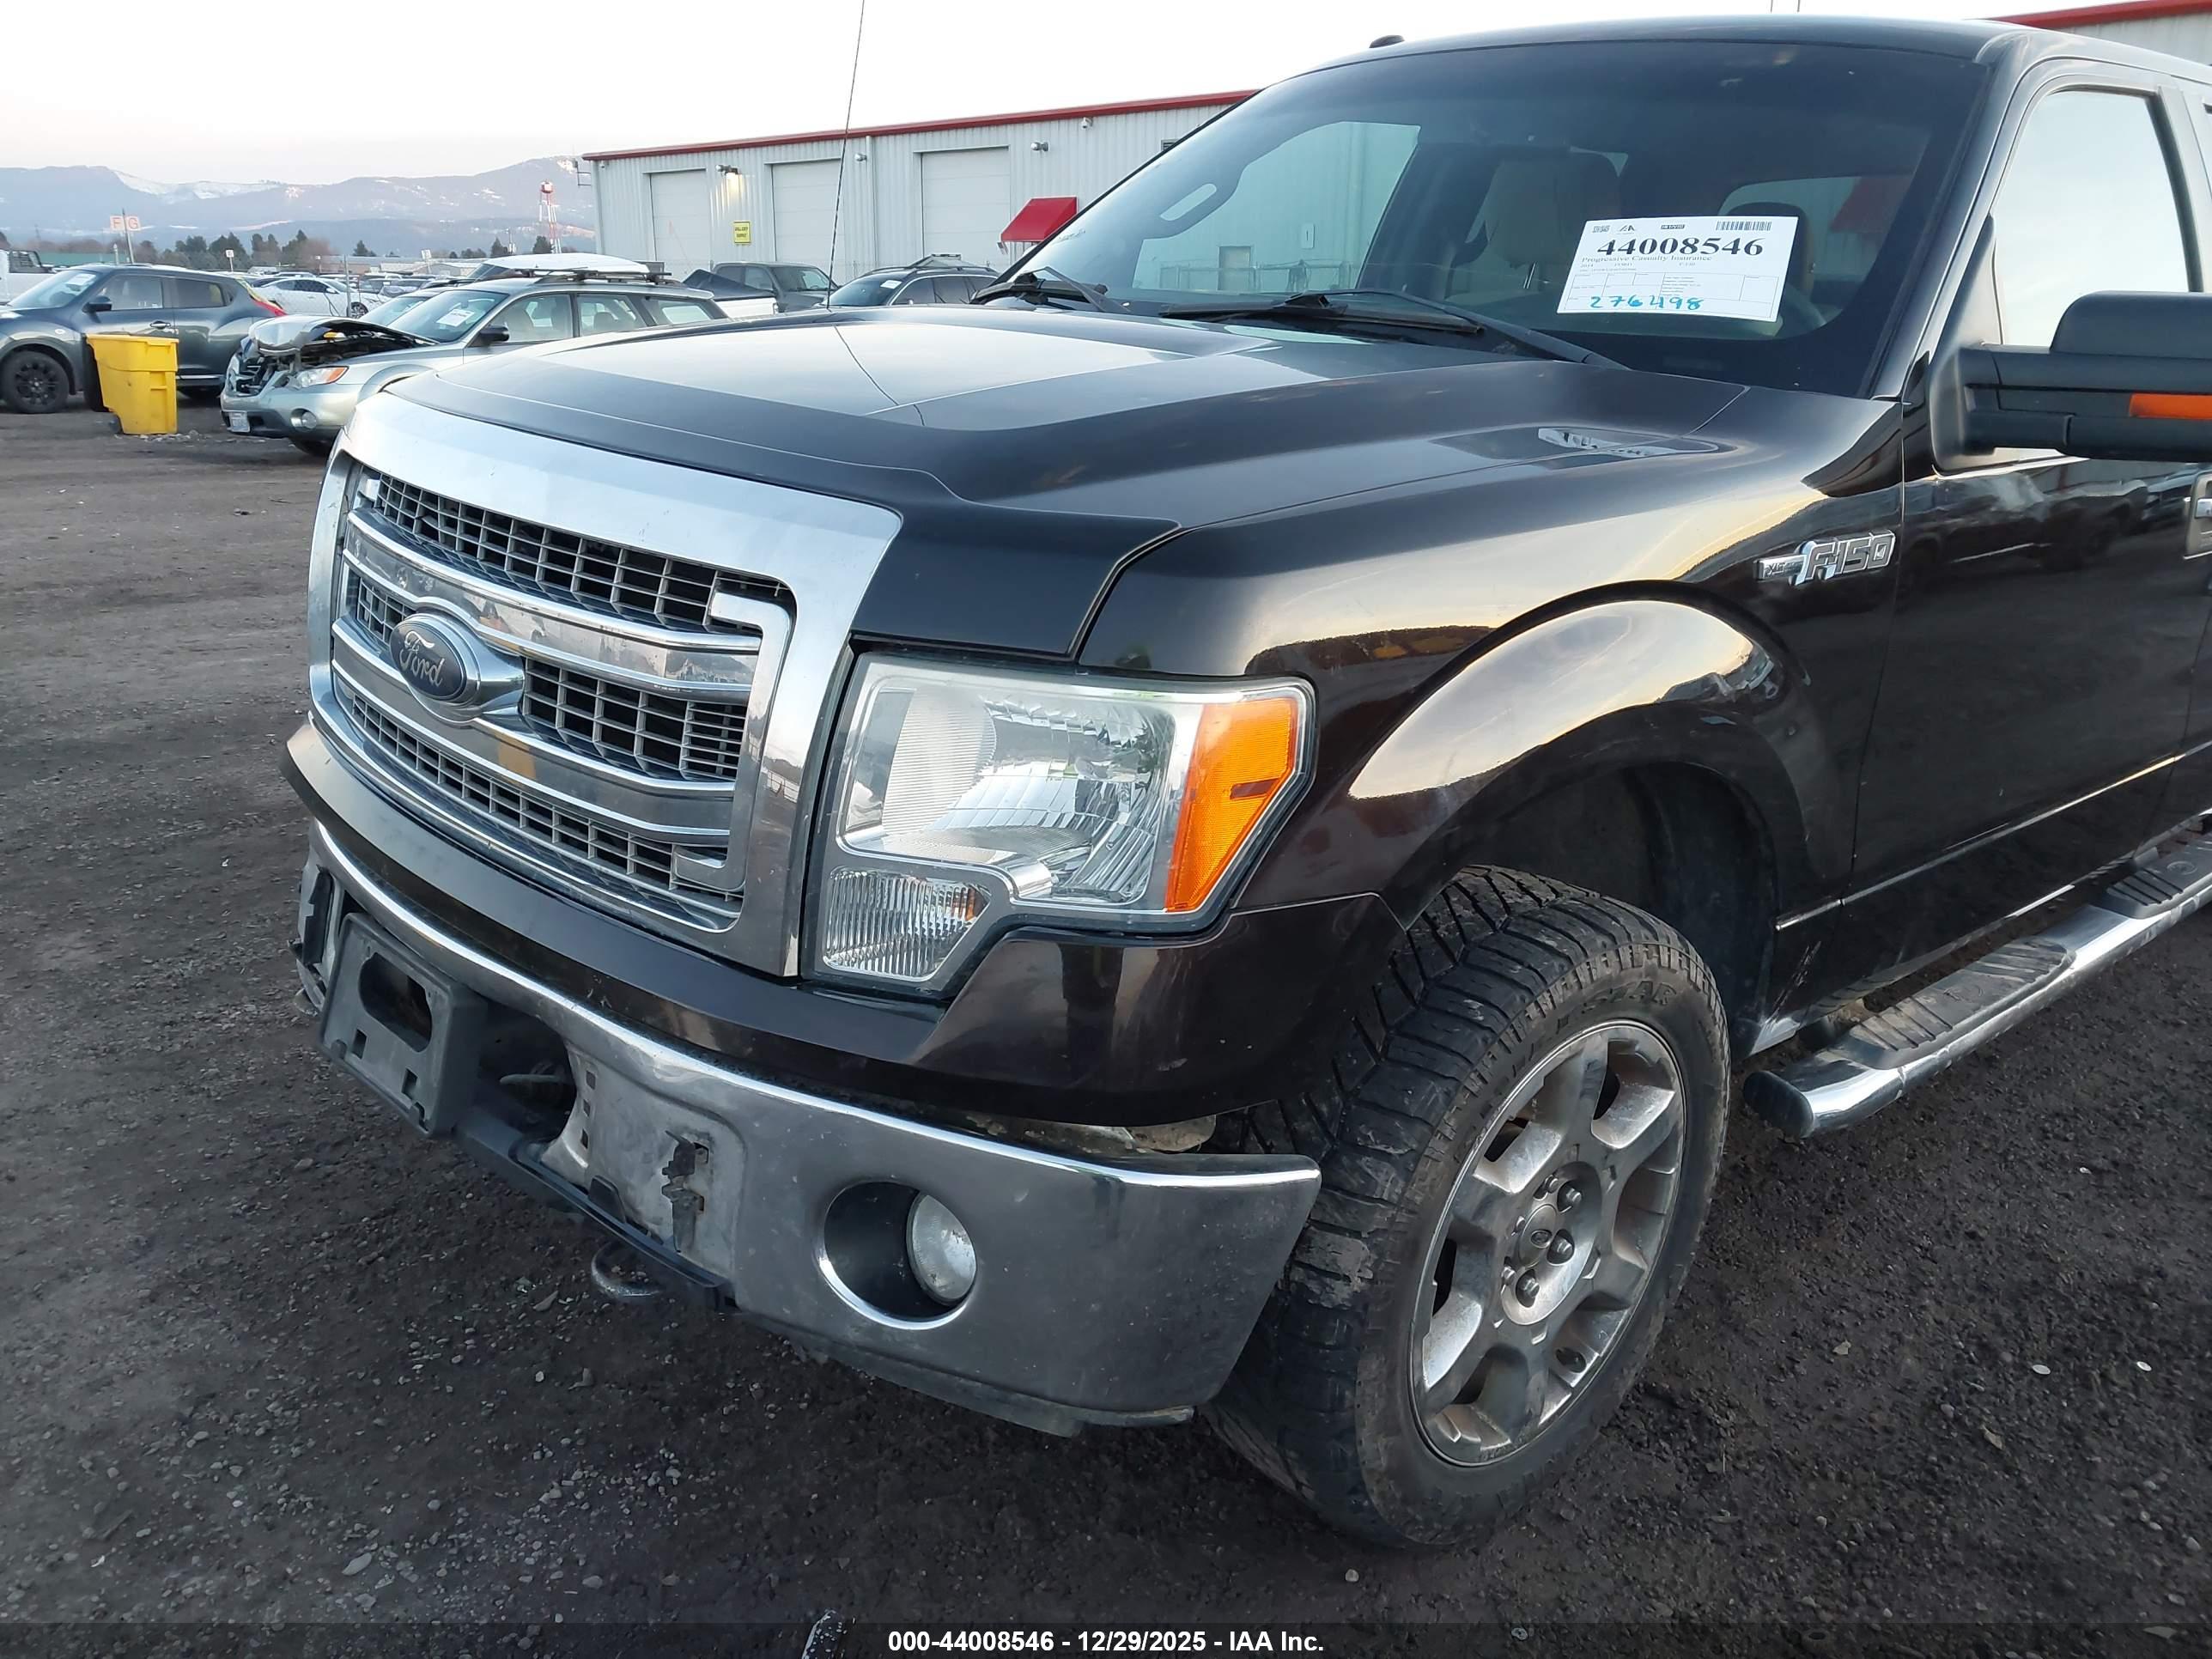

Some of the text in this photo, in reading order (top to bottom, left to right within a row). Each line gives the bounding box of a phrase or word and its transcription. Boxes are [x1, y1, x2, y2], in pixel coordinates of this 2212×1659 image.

[1596, 237, 1766, 256] 44008546
[1632, 255, 1668, 264] Casualty
[1589, 295, 1705, 310] 276498
[398, 631, 445, 687] Ford
